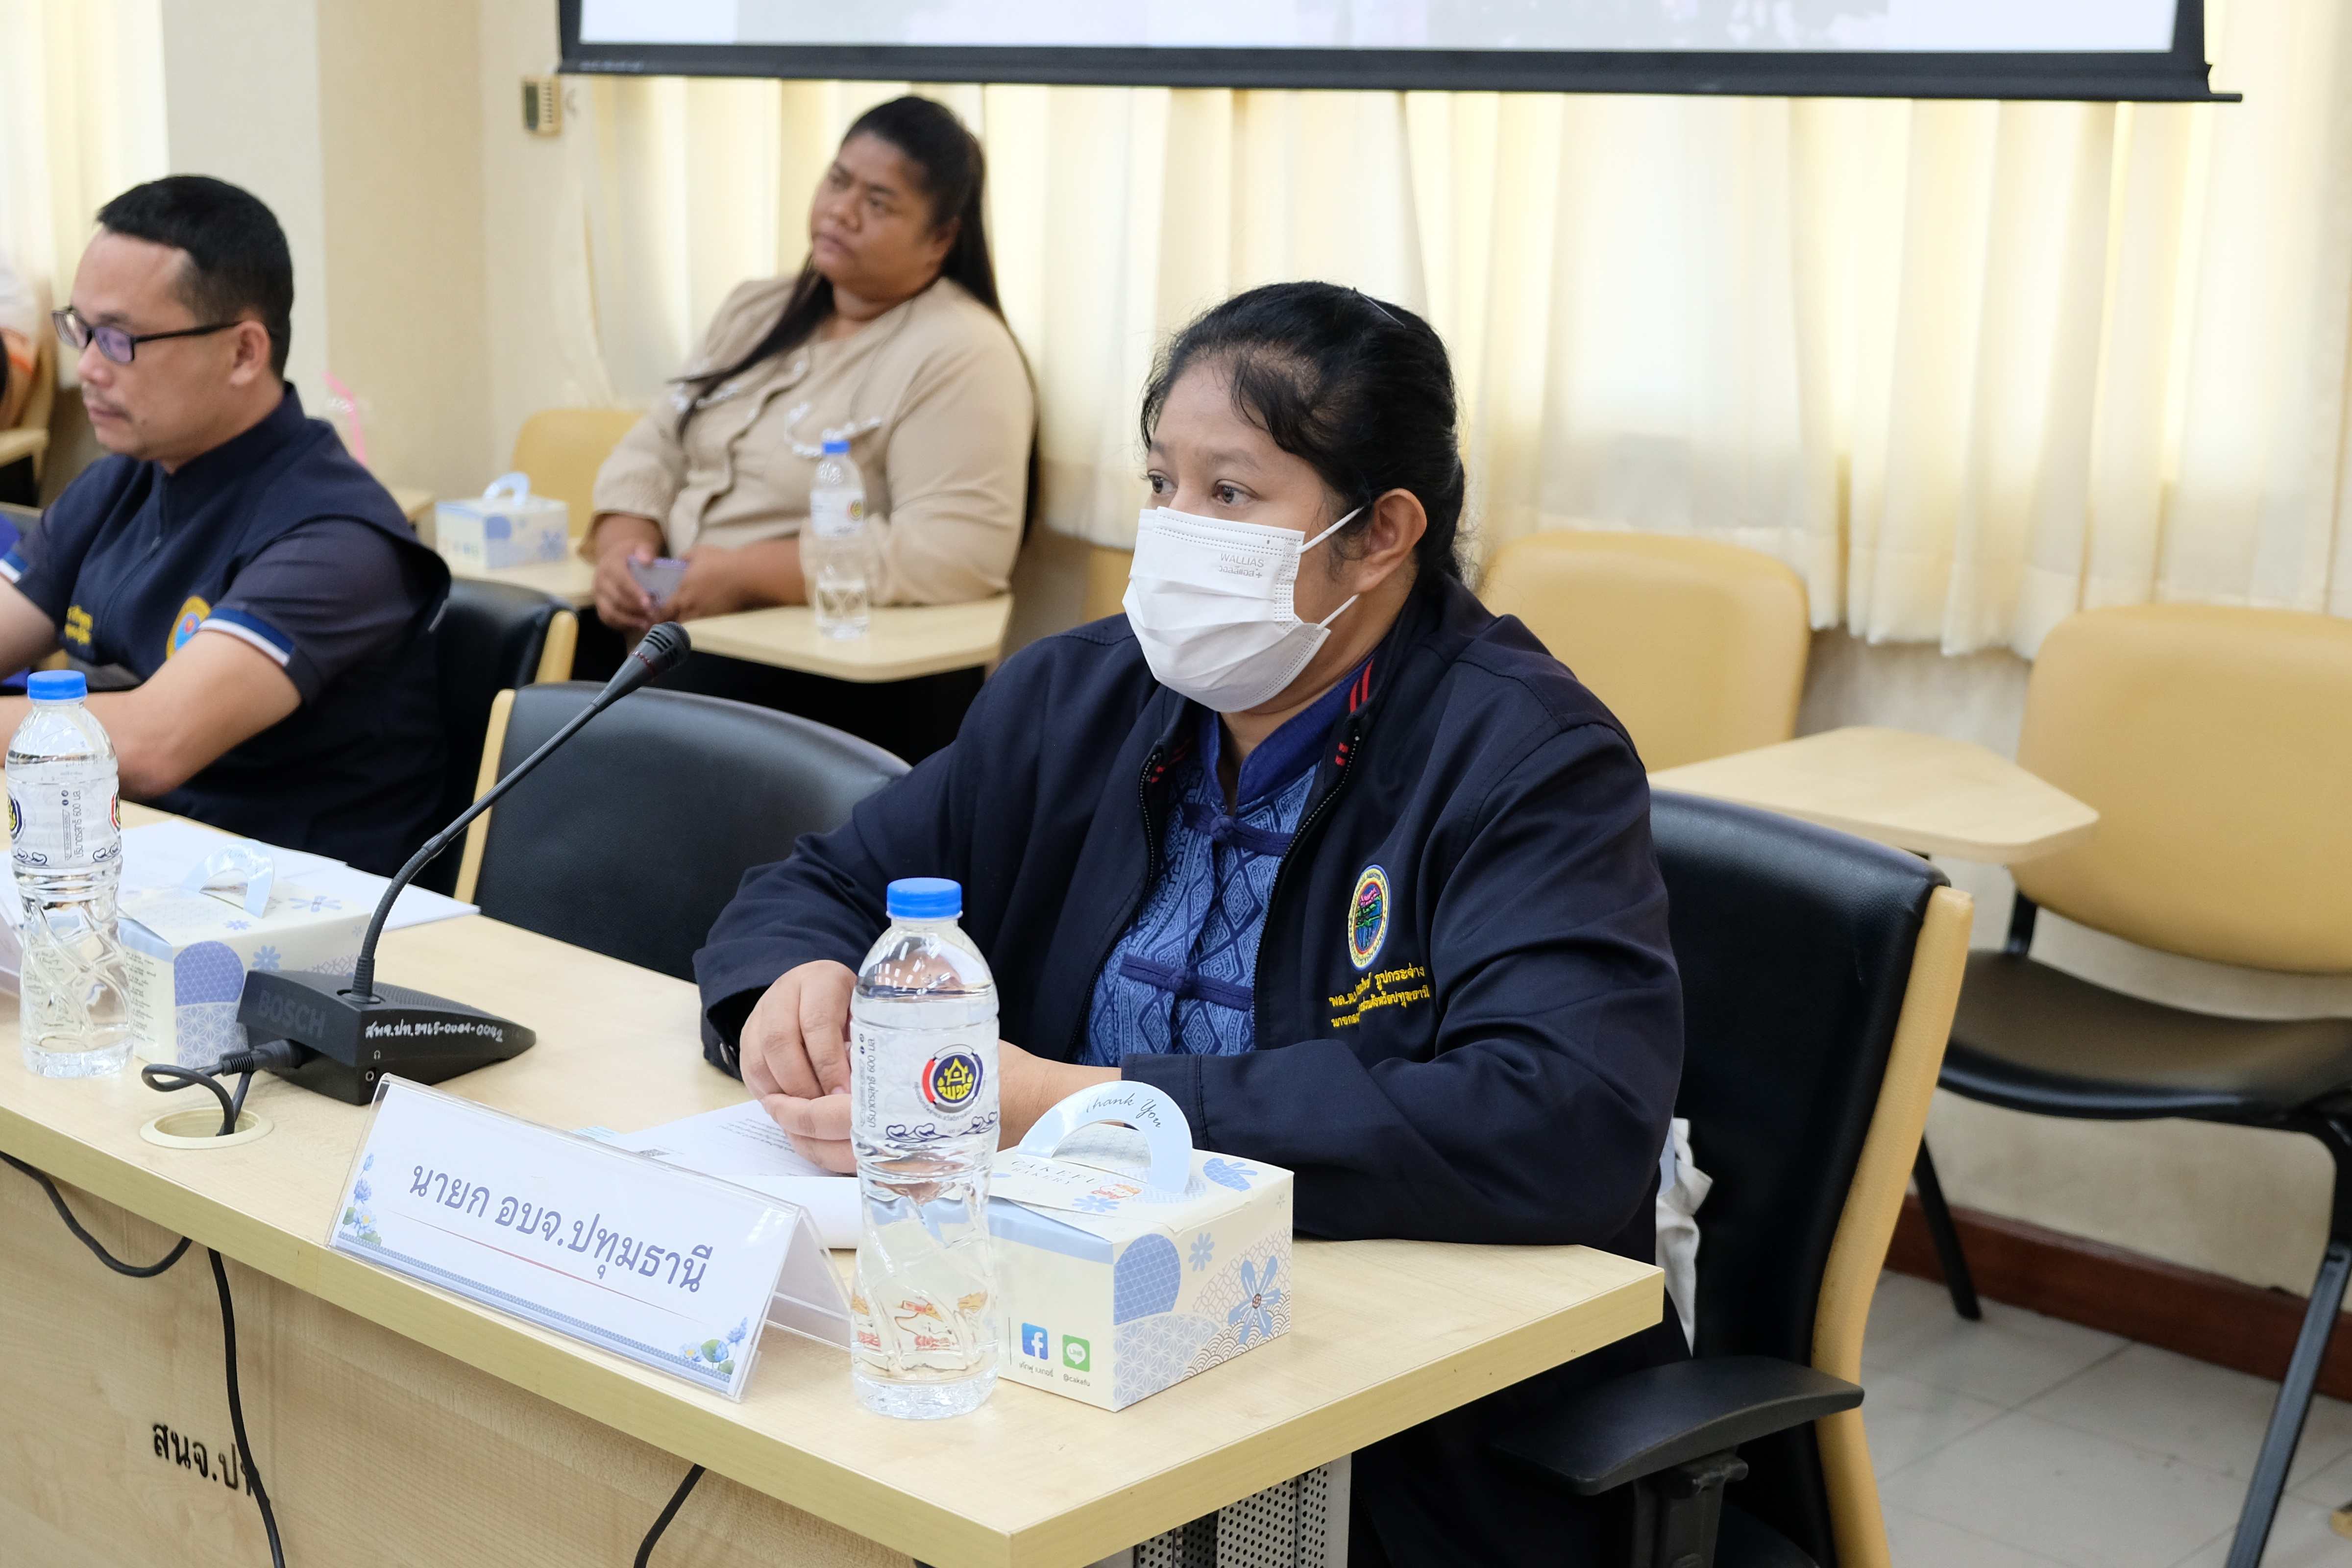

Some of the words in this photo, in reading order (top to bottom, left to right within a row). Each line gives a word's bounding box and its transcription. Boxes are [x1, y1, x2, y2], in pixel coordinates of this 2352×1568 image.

[1220, 553, 1264, 567] WALLIAS
[73, 803, 82, 816] 600
[257, 990, 326, 1038] BOSCH
[867, 1055, 876, 1073] 600
[867, 1076, 879, 1128] ปริมาตรสุทธิ
[1086, 1092, 1135, 1114] Thank
[1135, 1099, 1161, 1128] You
[1011, 1160, 1102, 1184] CAKEFU
[1011, 1168, 1075, 1185] BAKERY
[409, 1165, 490, 1218] นายก
[495, 1196, 713, 1293] อบจ.ปทุมธานี
[1069, 1348, 1083, 1357] LINE
[1063, 1374, 1090, 1387] @cakefu
